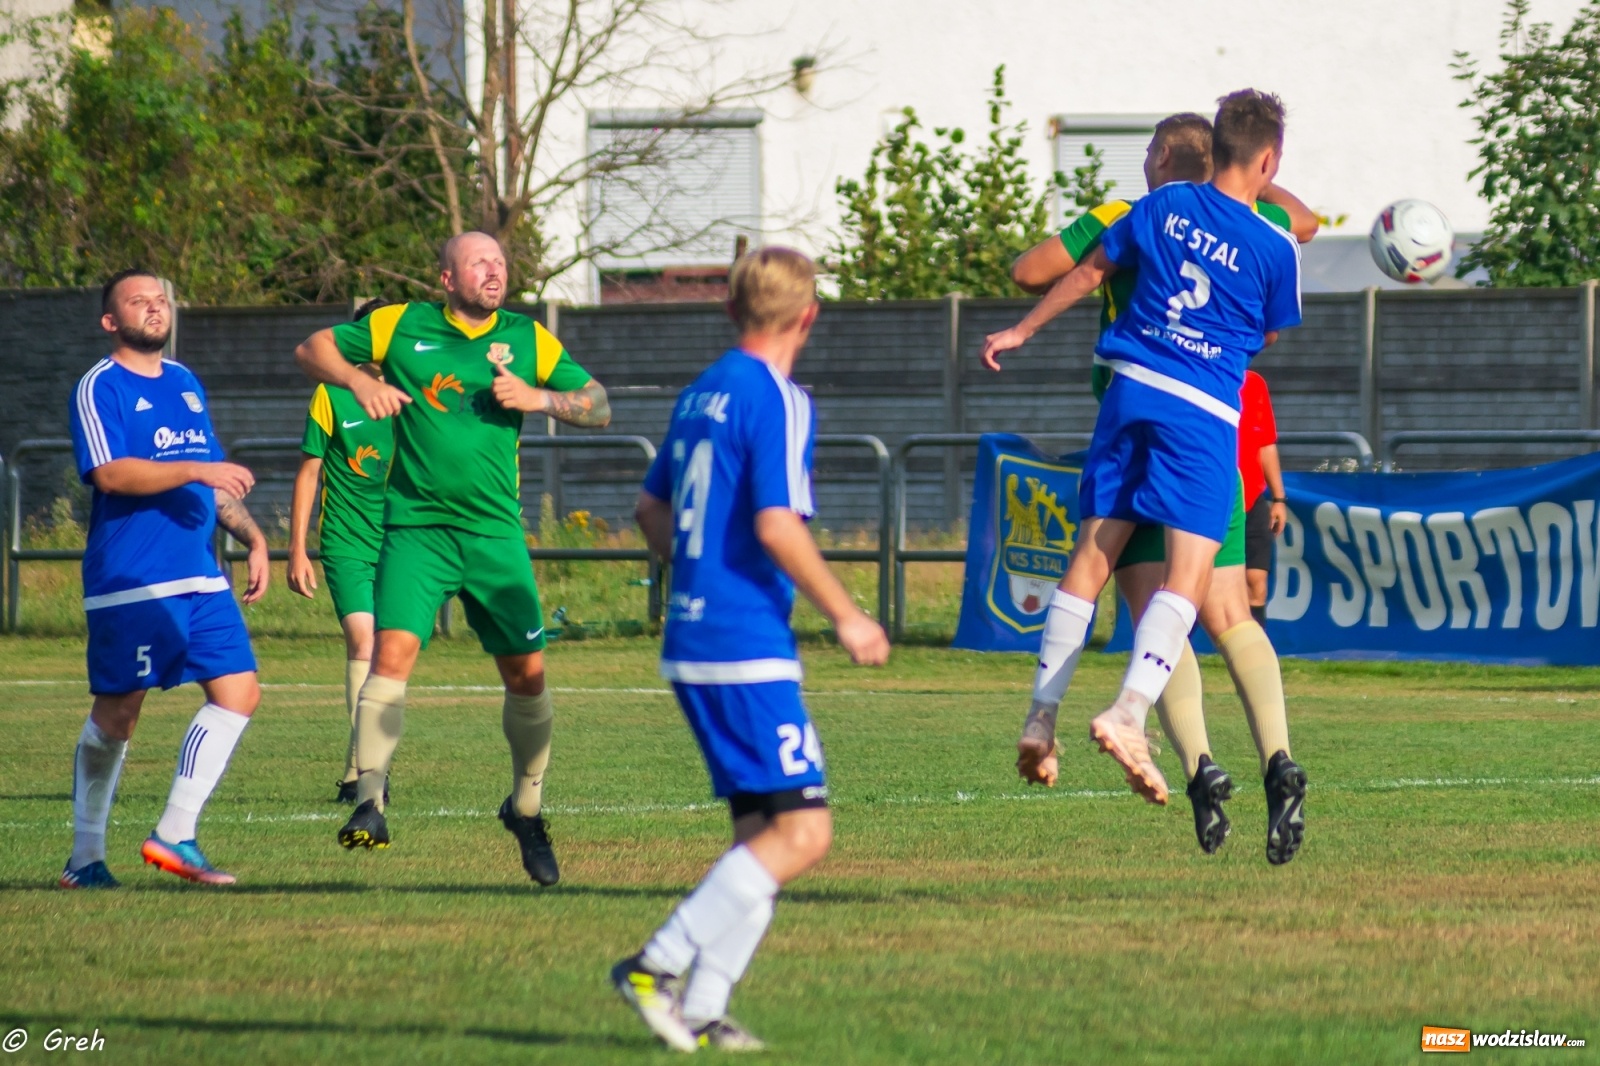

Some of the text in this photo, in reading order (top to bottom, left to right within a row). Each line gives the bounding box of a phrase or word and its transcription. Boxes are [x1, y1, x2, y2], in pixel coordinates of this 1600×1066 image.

[1164, 213, 1240, 272] KS STAL
[1165, 260, 1211, 338] 2
[1032, 555, 1065, 574] STAL
[136, 645, 152, 677] 5
[776, 722, 824, 776] 24
